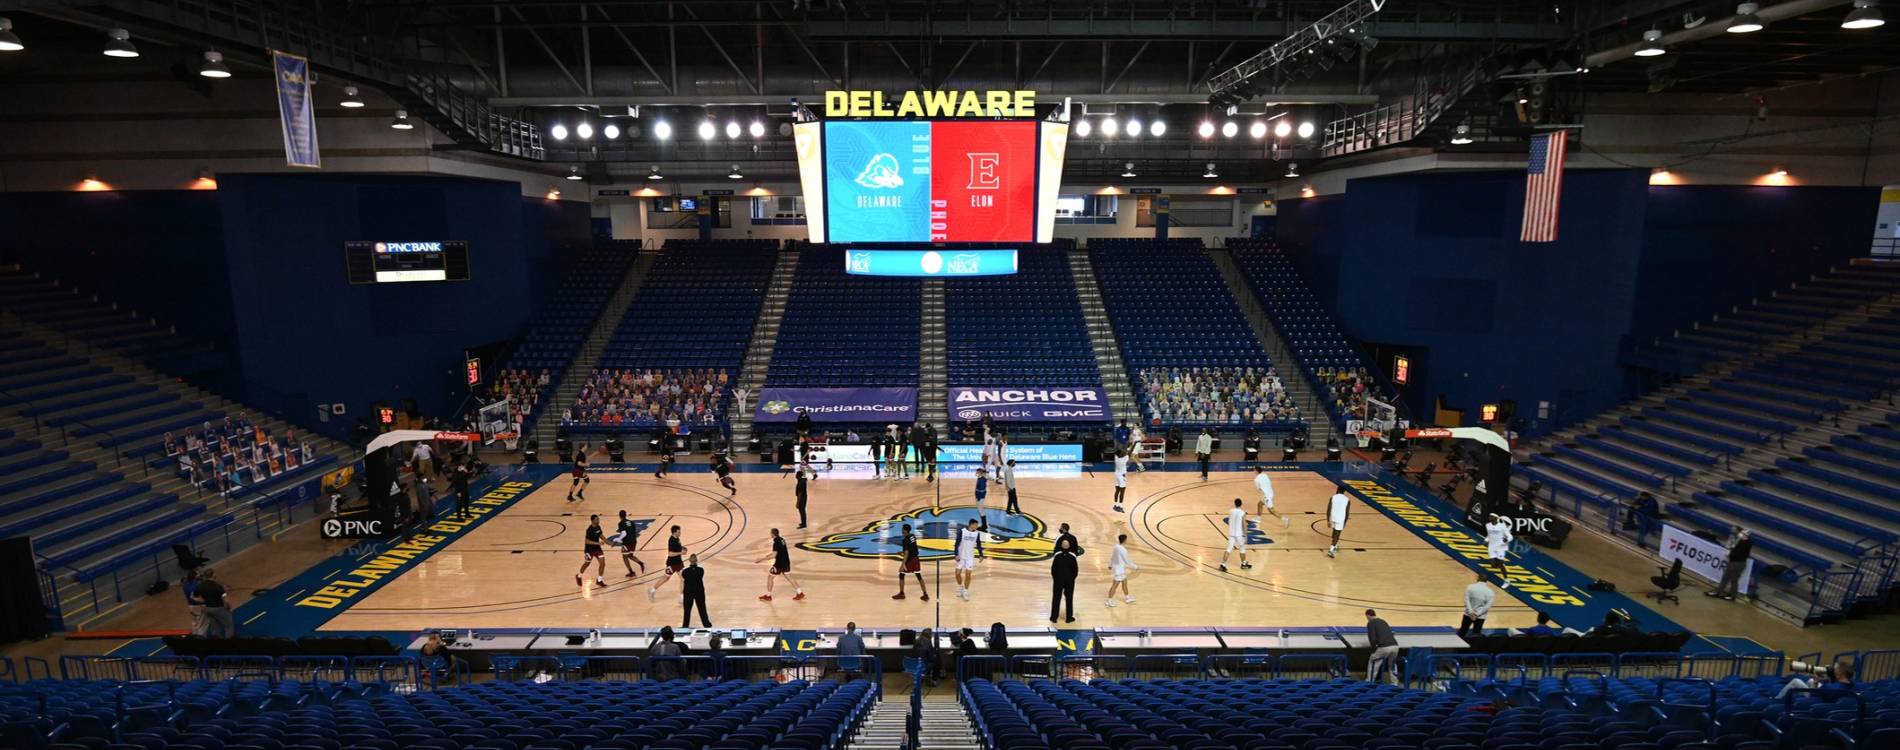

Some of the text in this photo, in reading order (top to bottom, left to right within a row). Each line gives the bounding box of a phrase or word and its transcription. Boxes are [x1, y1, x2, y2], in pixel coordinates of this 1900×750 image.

[825, 90, 1035, 117] DELAWARE
[857, 195, 902, 208] DELAWARE
[971, 195, 993, 207] ELON
[955, 390, 1098, 402] ANCHOR
[1043, 409, 1104, 417] GMC
[944, 446, 969, 454] Official
[1009, 446, 1035, 456] System
[344, 520, 382, 535] PNC
[1514, 517, 1553, 532] PNC
[294, 533, 447, 609] DELAWARE
[471, 482, 533, 506] HENS
[1342, 480, 1453, 529] DELAWARE
[1477, 563, 1586, 607] HENS
[1675, 542, 1729, 571] FLOSPOR
